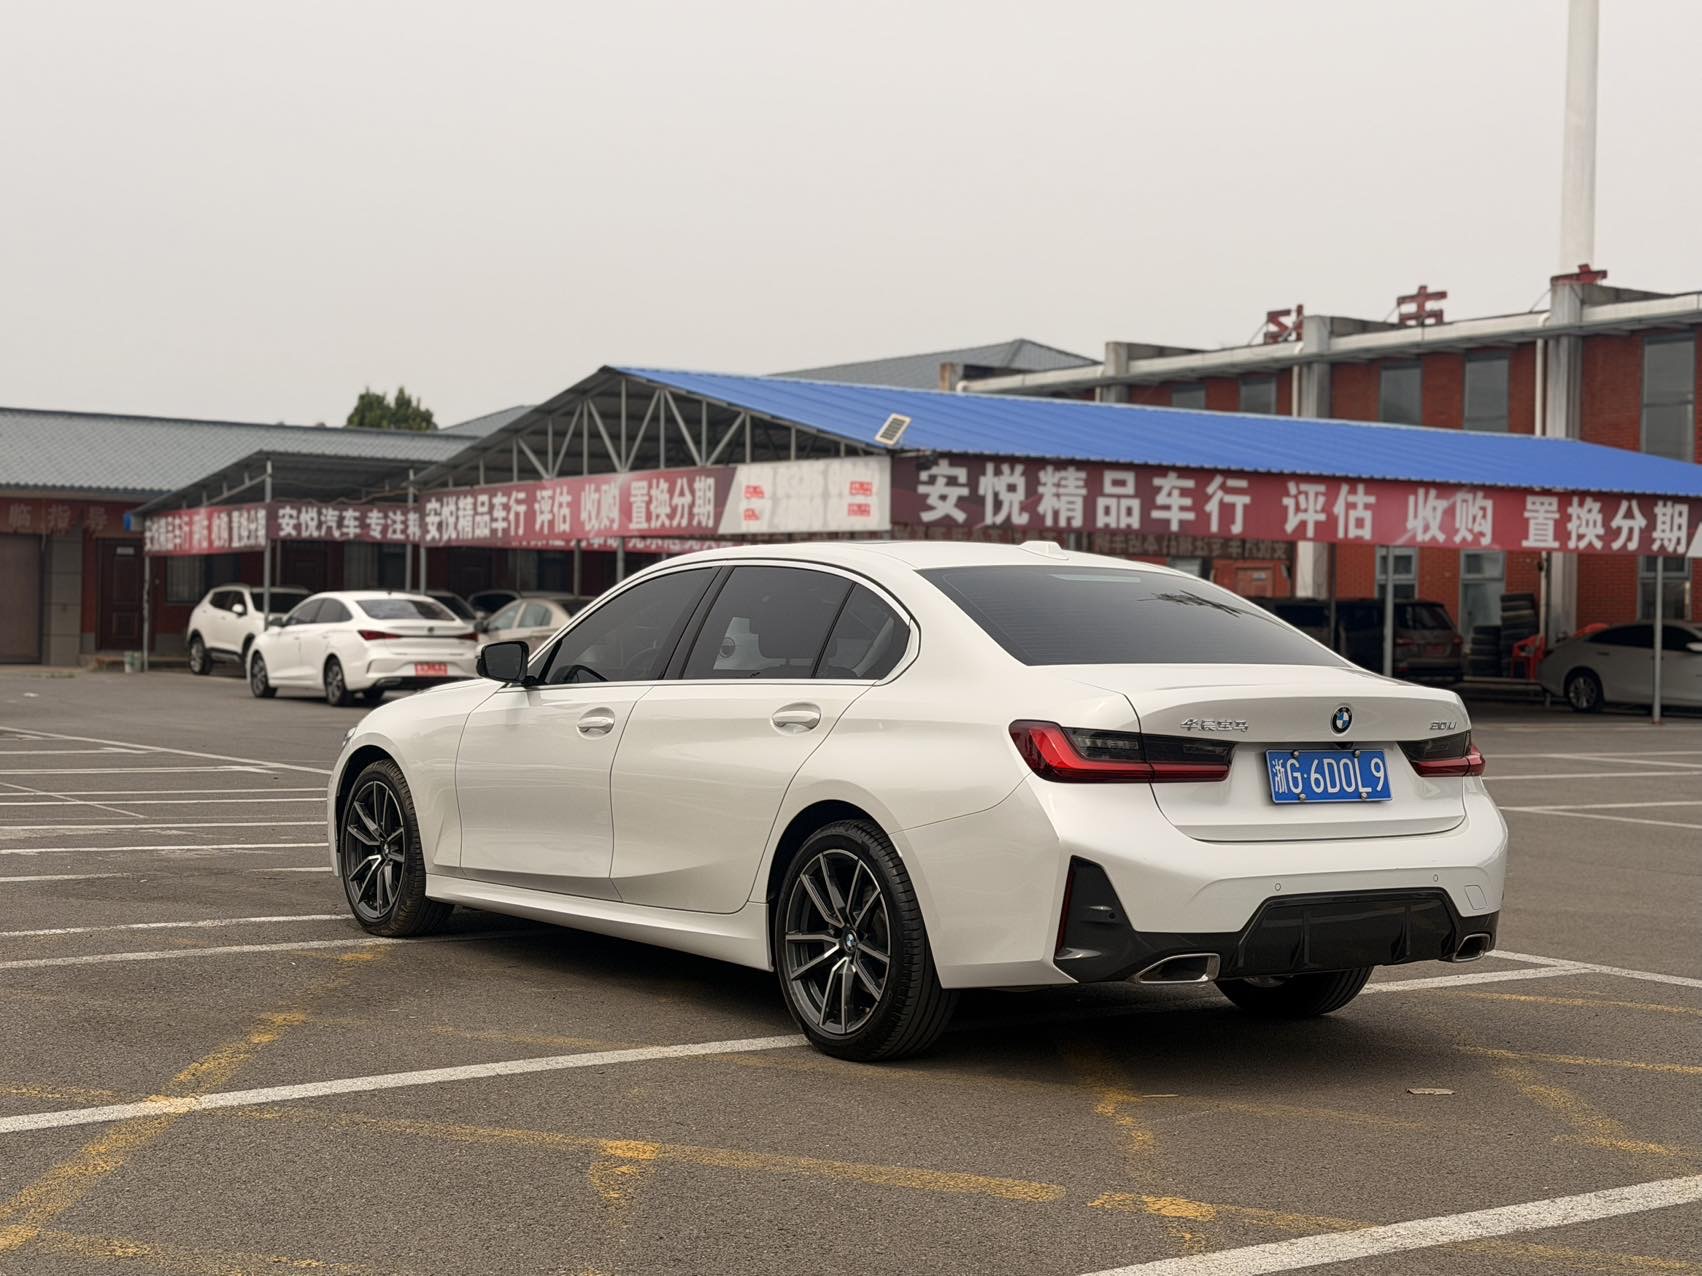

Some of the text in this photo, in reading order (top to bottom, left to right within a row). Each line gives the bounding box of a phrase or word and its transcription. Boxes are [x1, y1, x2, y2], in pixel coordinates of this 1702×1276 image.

[277, 505, 362, 538] 安悦汽车
[424, 489, 525, 542] 安悦精品车行
[534, 485, 571, 534] 评估
[580, 477, 621, 531] 收购
[629, 472, 716, 531] 置换分期
[917, 459, 1251, 534] 安悦精品车行
[1282, 480, 1376, 541] 评估
[1404, 487, 1494, 545] 收购
[1521, 494, 1690, 555] 置换分期
